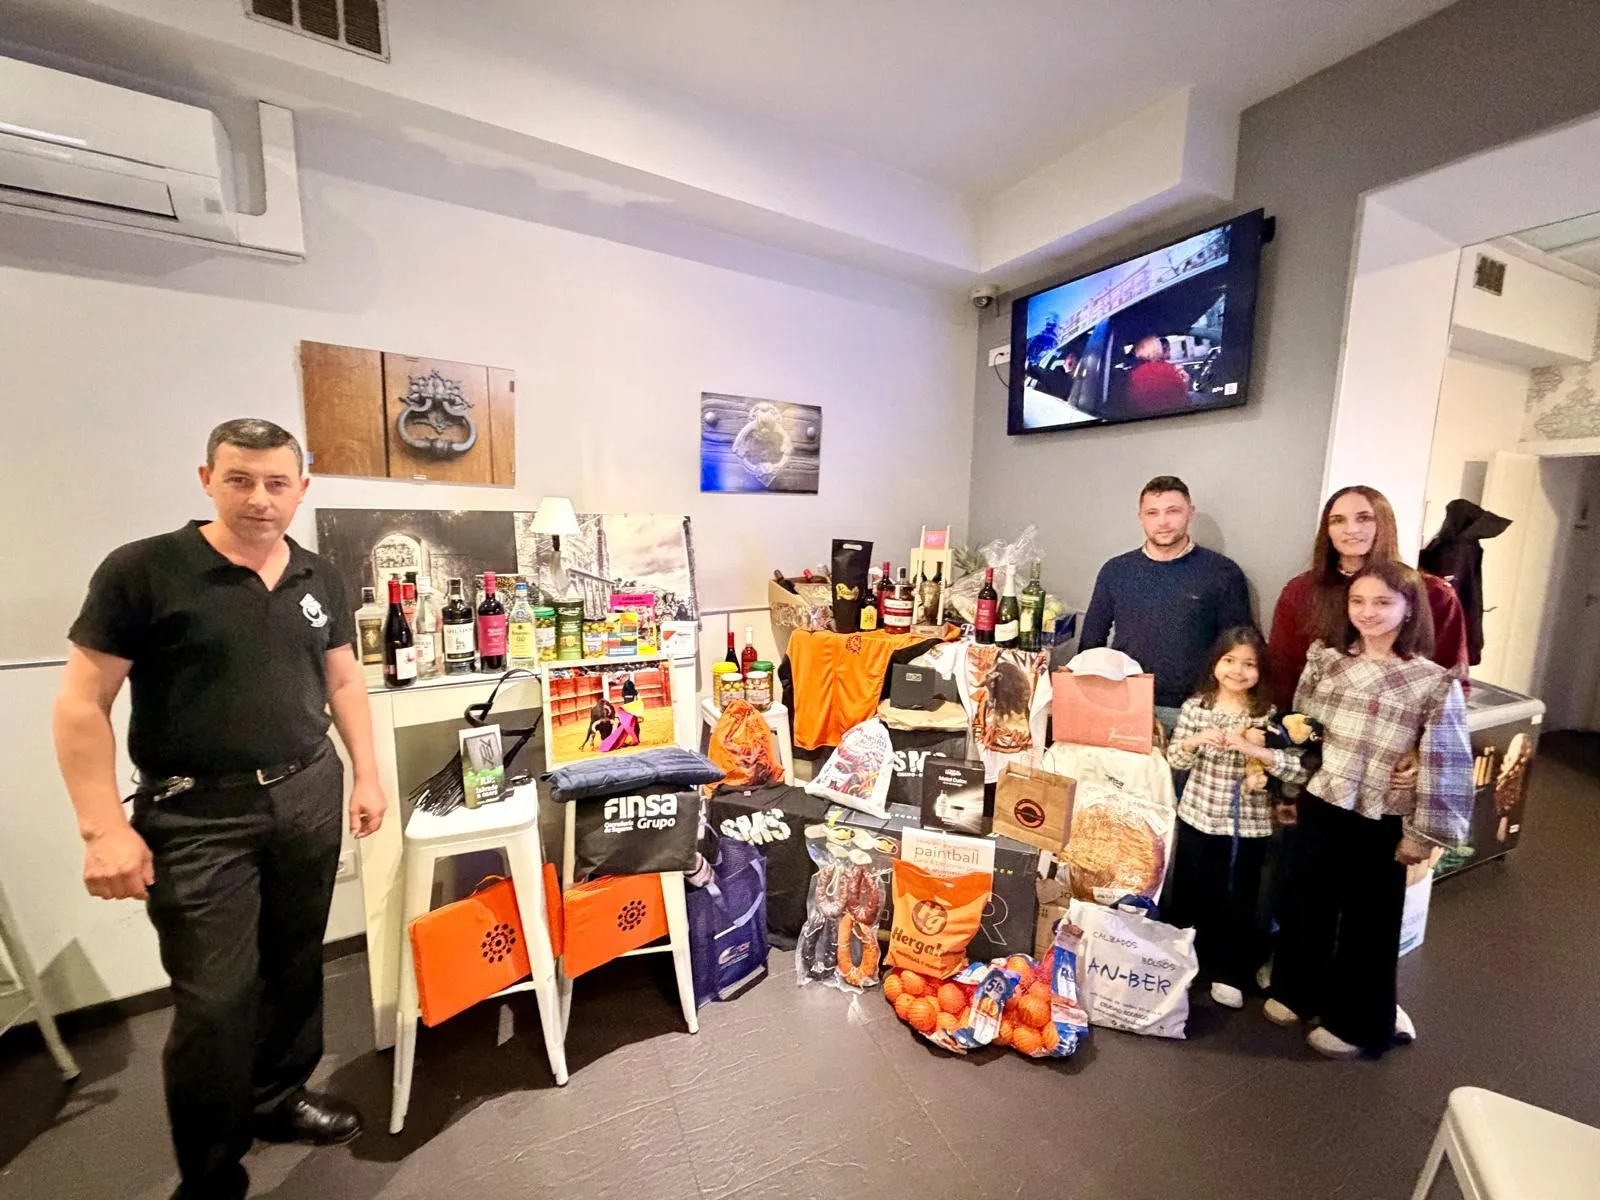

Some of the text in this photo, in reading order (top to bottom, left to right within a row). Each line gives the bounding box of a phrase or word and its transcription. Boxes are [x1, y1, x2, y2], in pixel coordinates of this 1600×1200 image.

[637, 817, 676, 830] Grupo
[915, 846, 979, 865] paintball
[1087, 957, 1171, 996] AN-BER
